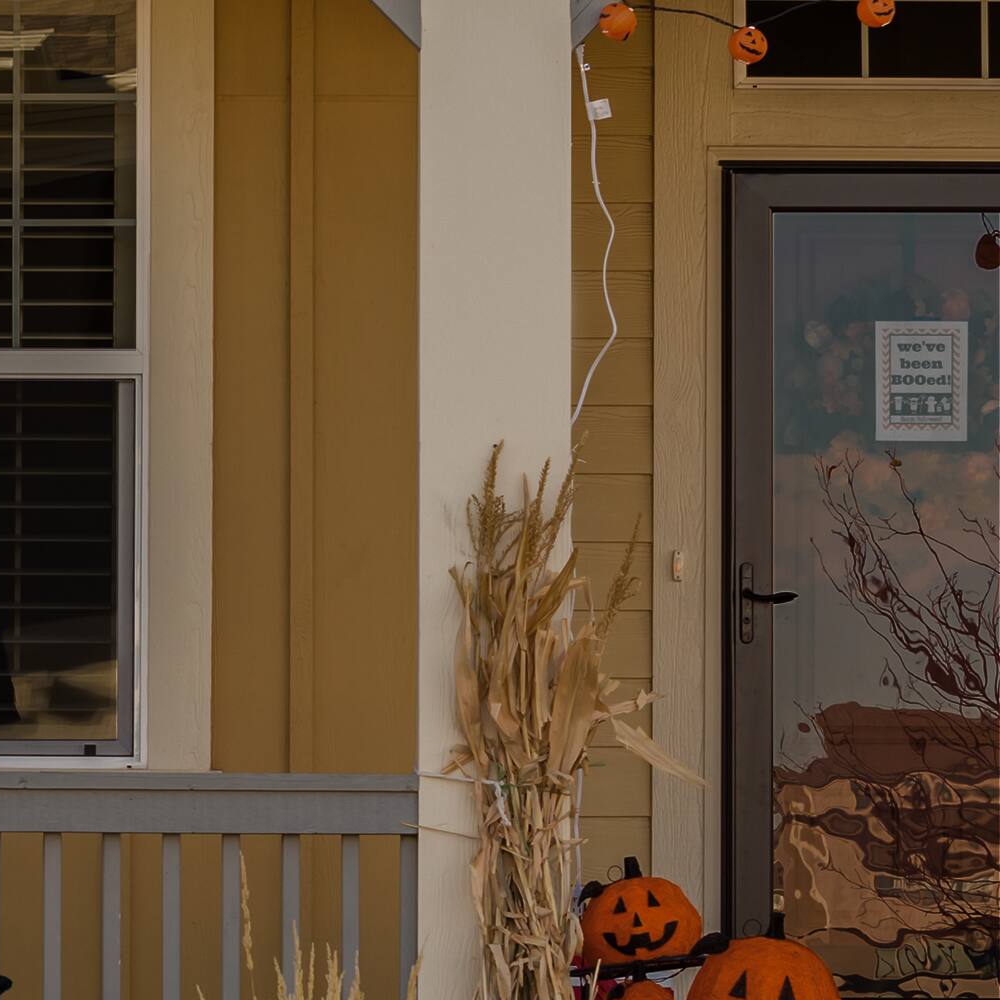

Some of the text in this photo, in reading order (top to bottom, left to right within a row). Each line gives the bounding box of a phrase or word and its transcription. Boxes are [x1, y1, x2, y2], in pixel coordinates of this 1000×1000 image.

[897, 341, 946, 352] we've
[900, 358, 943, 369] been
[891, 374, 951, 385] BOOed!
